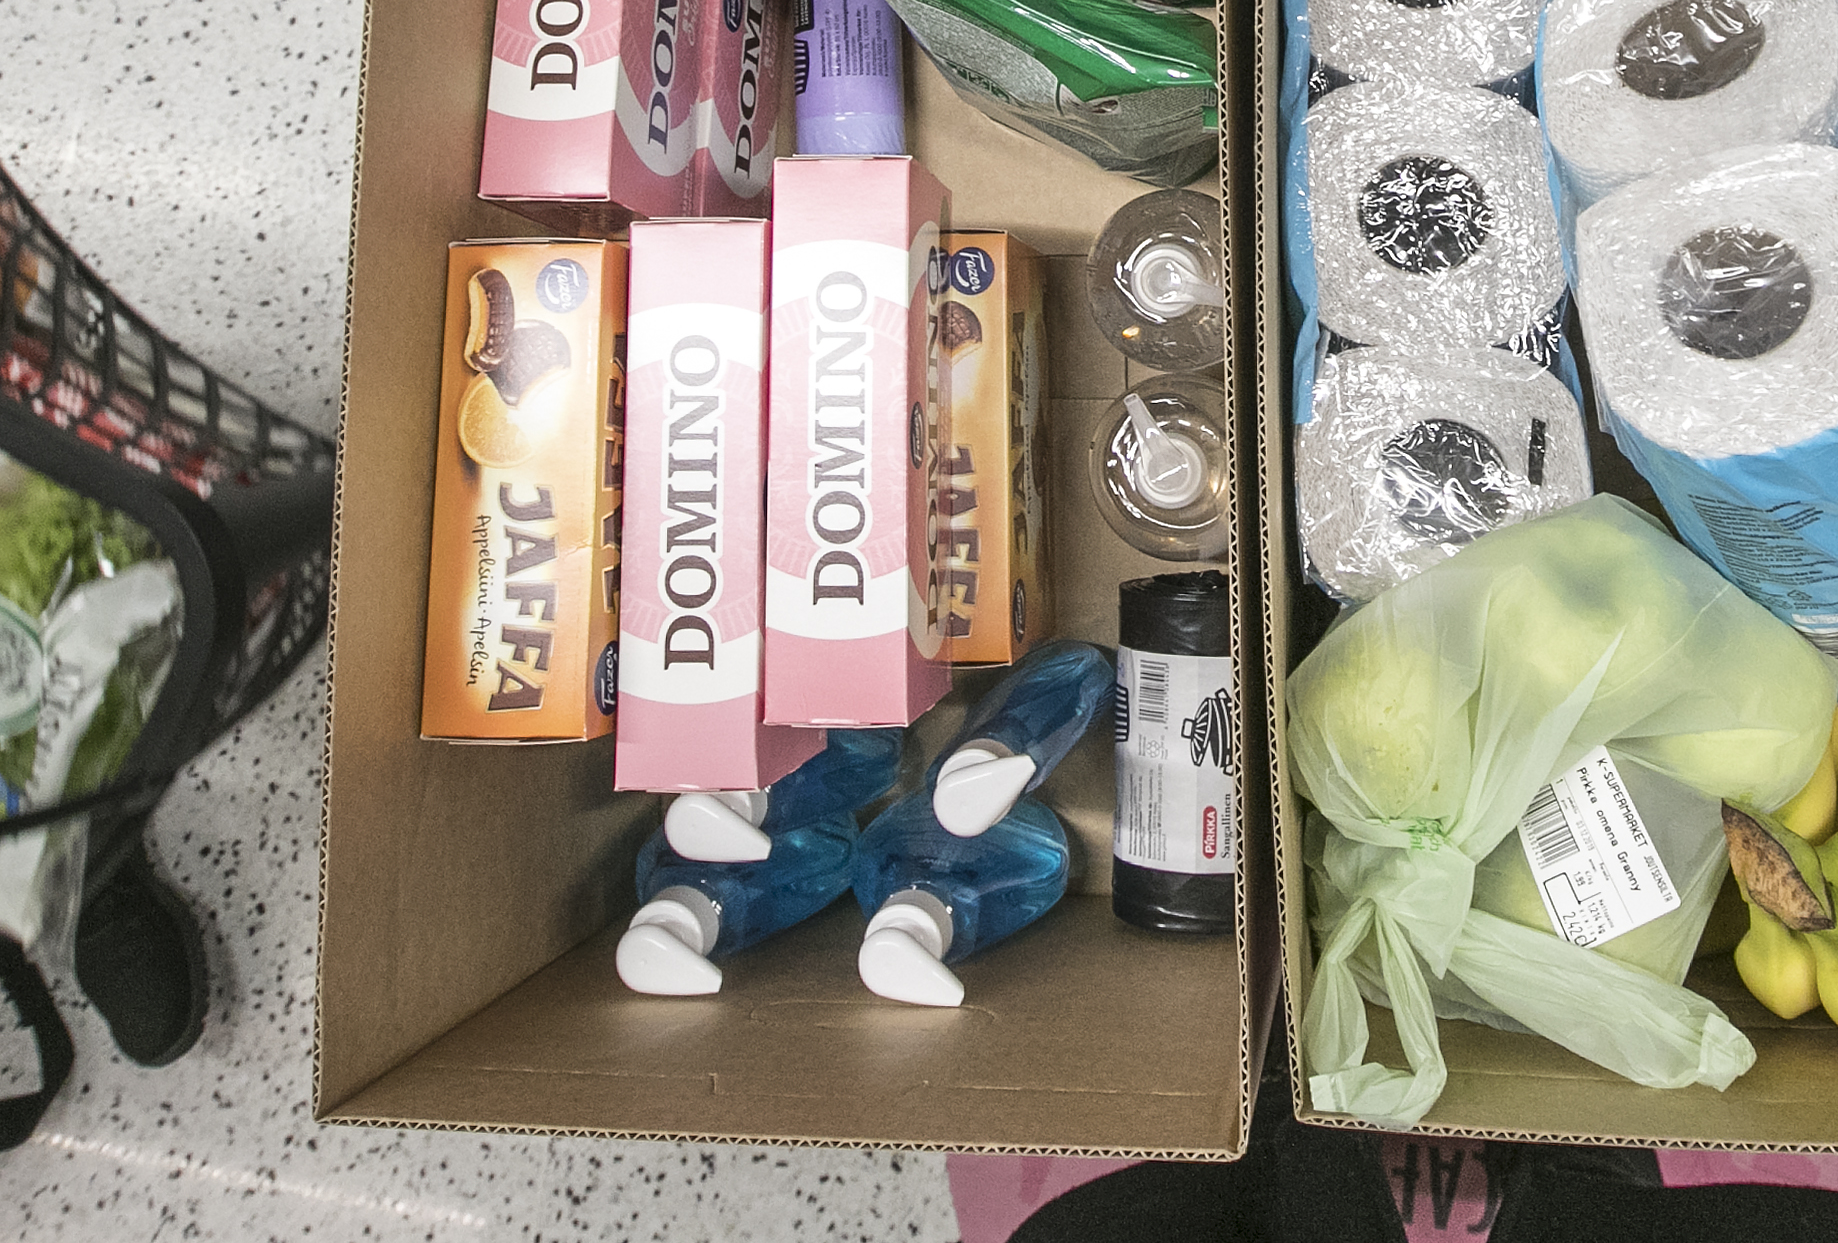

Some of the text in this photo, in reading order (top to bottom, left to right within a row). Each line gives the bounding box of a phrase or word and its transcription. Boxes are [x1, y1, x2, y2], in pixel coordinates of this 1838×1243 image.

[551, 263, 576, 311] Fazer
[960, 250, 990, 293] Fazer
[664, 335, 722, 671] DOMINO
[812, 270, 868, 607] DOMINO
[926, 244, 939, 634] DOMINO
[1010, 311, 1028, 555] JAFFA
[466, 513, 494, 687] Appelsiini Apelsin
[487, 482, 558, 713] JAFFA
[938, 444, 980, 638] JAFFA
[601, 647, 618, 714] Fazer
[1221, 793, 1232, 859] Sangallinen
[1575, 766, 1644, 893] Pirkka omena Granny
[1595, 758, 1648, 848] K-SUPERMARKET
